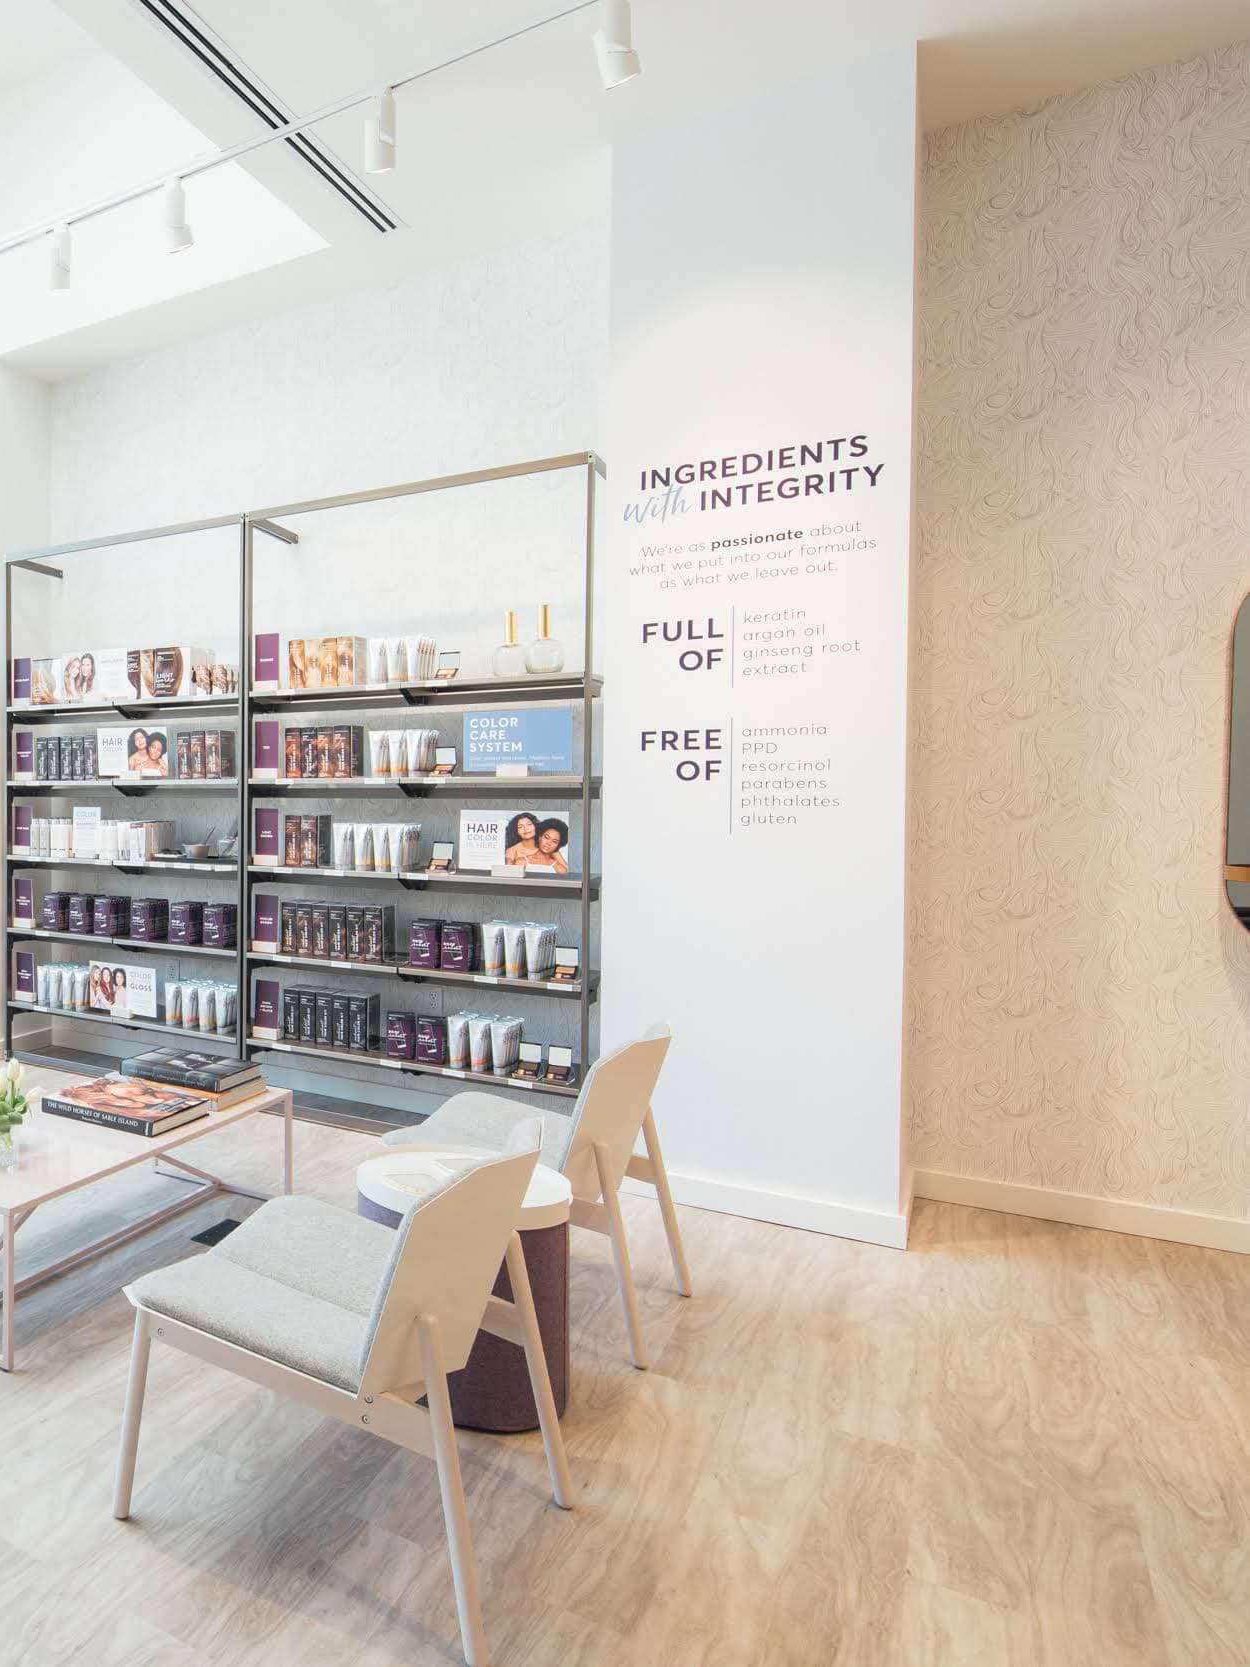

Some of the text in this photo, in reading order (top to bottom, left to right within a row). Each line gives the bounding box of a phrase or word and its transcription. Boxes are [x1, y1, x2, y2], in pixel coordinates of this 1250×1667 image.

[640, 434, 869, 491] INGREDIENTS
[623, 463, 885, 524] with INTEGRITY
[641, 520, 862, 558] We're as passionate about
[629, 538, 877, 577] what we put into our formulas
[659, 577, 677, 590] as
[682, 568, 721, 587] what
[727, 571, 750, 583] we
[755, 563, 799, 580] leave
[743, 608, 807, 625] keratin
[642, 617, 725, 643] FULL
[743, 623, 826, 643] argan oil
[742, 639, 862, 662] ginseng root
[678, 648, 724, 671] OF
[742, 661, 808, 677] extract
[470, 717, 519, 729] COLOR
[741, 722, 828, 738] ammonia
[102, 737, 123, 747] HAIR
[469, 729, 507, 741] CARE
[640, 729, 723, 752] FREE
[469, 741, 523, 753] SYSTEM
[742, 741, 779, 755] PPD
[675, 760, 723, 782] OF
[741, 758, 832, 773] resorcinol
[741, 777, 828, 791] parabens
[741, 794, 841, 809] phthalates
[740, 812, 798, 828] gluten
[467, 823, 498, 834] HAIR
[467, 833, 498, 842] COLOR
[130, 982, 152, 992] GLOSS
[47, 1100, 58, 1109] THE
[58, 1103, 72, 1112] WILD
[72, 1107, 92, 1117] HORSES
[101, 1113, 117, 1123] SABLE
[117, 1116, 139, 1127] ISLAND
